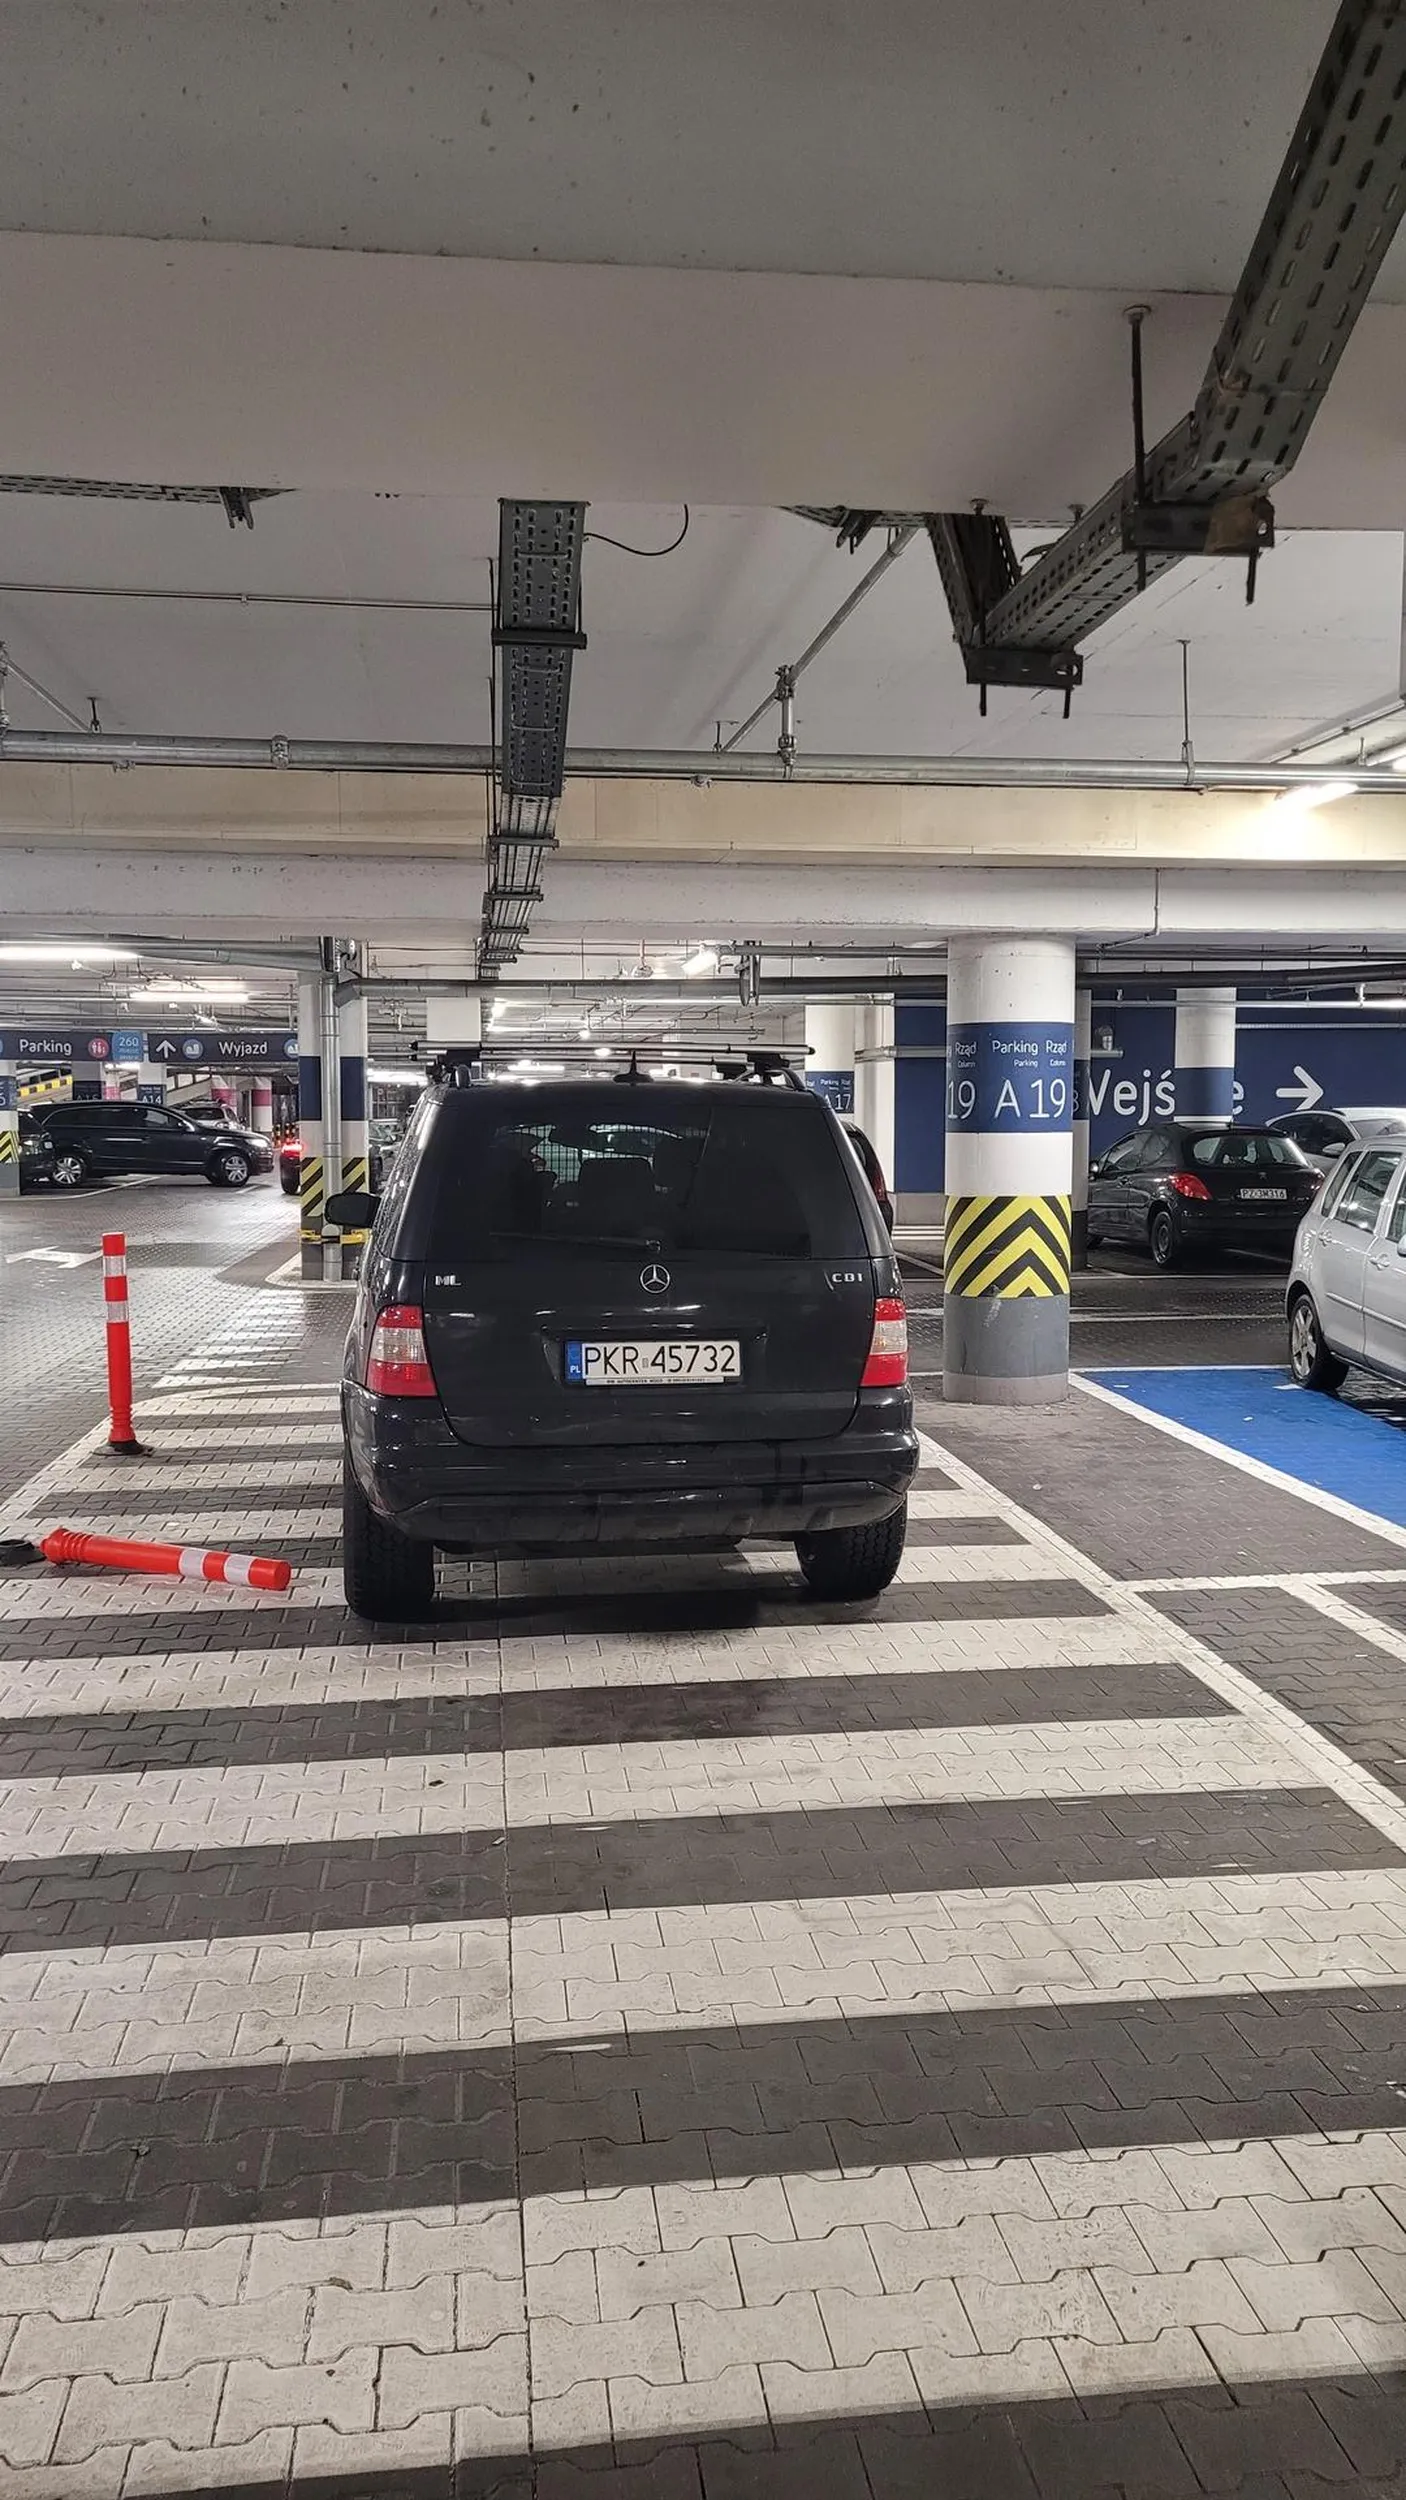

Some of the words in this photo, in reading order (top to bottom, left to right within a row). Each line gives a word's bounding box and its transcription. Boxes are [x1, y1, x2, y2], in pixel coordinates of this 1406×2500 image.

[20, 1039, 72, 1056] Parking
[119, 1037, 139, 1047] 260
[218, 1041, 268, 1057] Wyjazd
[992, 1040, 1039, 1055] Parking
[1046, 1039, 1067, 1056] Rząd
[1014, 1059, 1039, 1068] Parking
[947, 1080, 976, 1119] 19
[993, 1078, 1021, 1119] A
[1029, 1078, 1067, 1118] 19
[1089, 1069, 1244, 1126] Wejś
[435, 1275, 462, 1286] ML
[585, 1345, 640, 1375] PKR
[650, 1344, 736, 1374] 45732
[569, 1365, 581, 1374] PL
